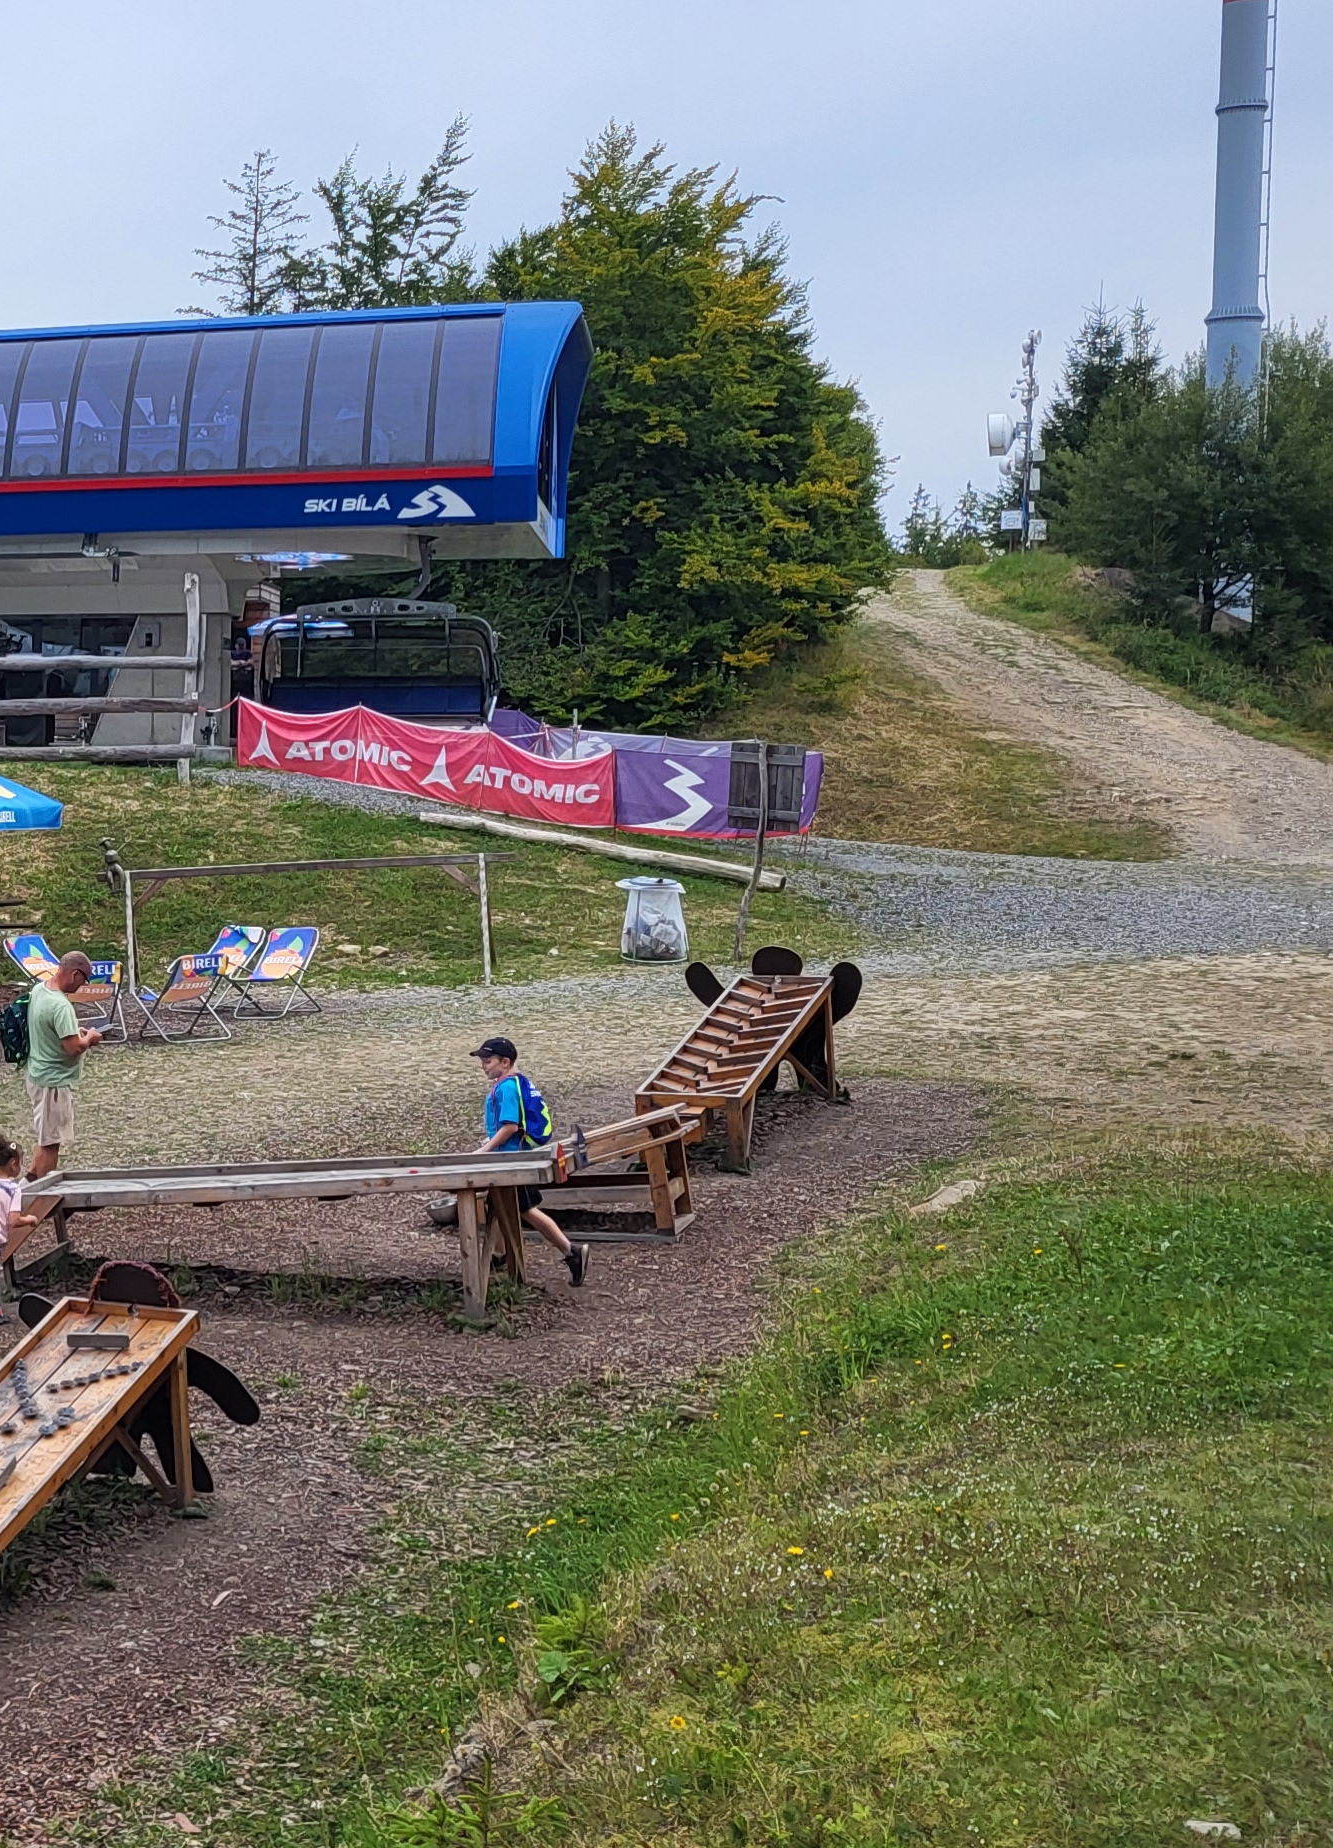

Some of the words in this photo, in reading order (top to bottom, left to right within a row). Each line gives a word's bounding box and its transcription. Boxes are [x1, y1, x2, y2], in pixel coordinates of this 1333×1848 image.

[304, 498, 337, 513] SKI
[341, 493, 391, 512] BÍLÁ
[284, 739, 413, 771] ATOMIC
[463, 764, 600, 804] ATOMIC
[182, 957, 224, 971] BIRELL
[265, 955, 305, 965] BIRELL
